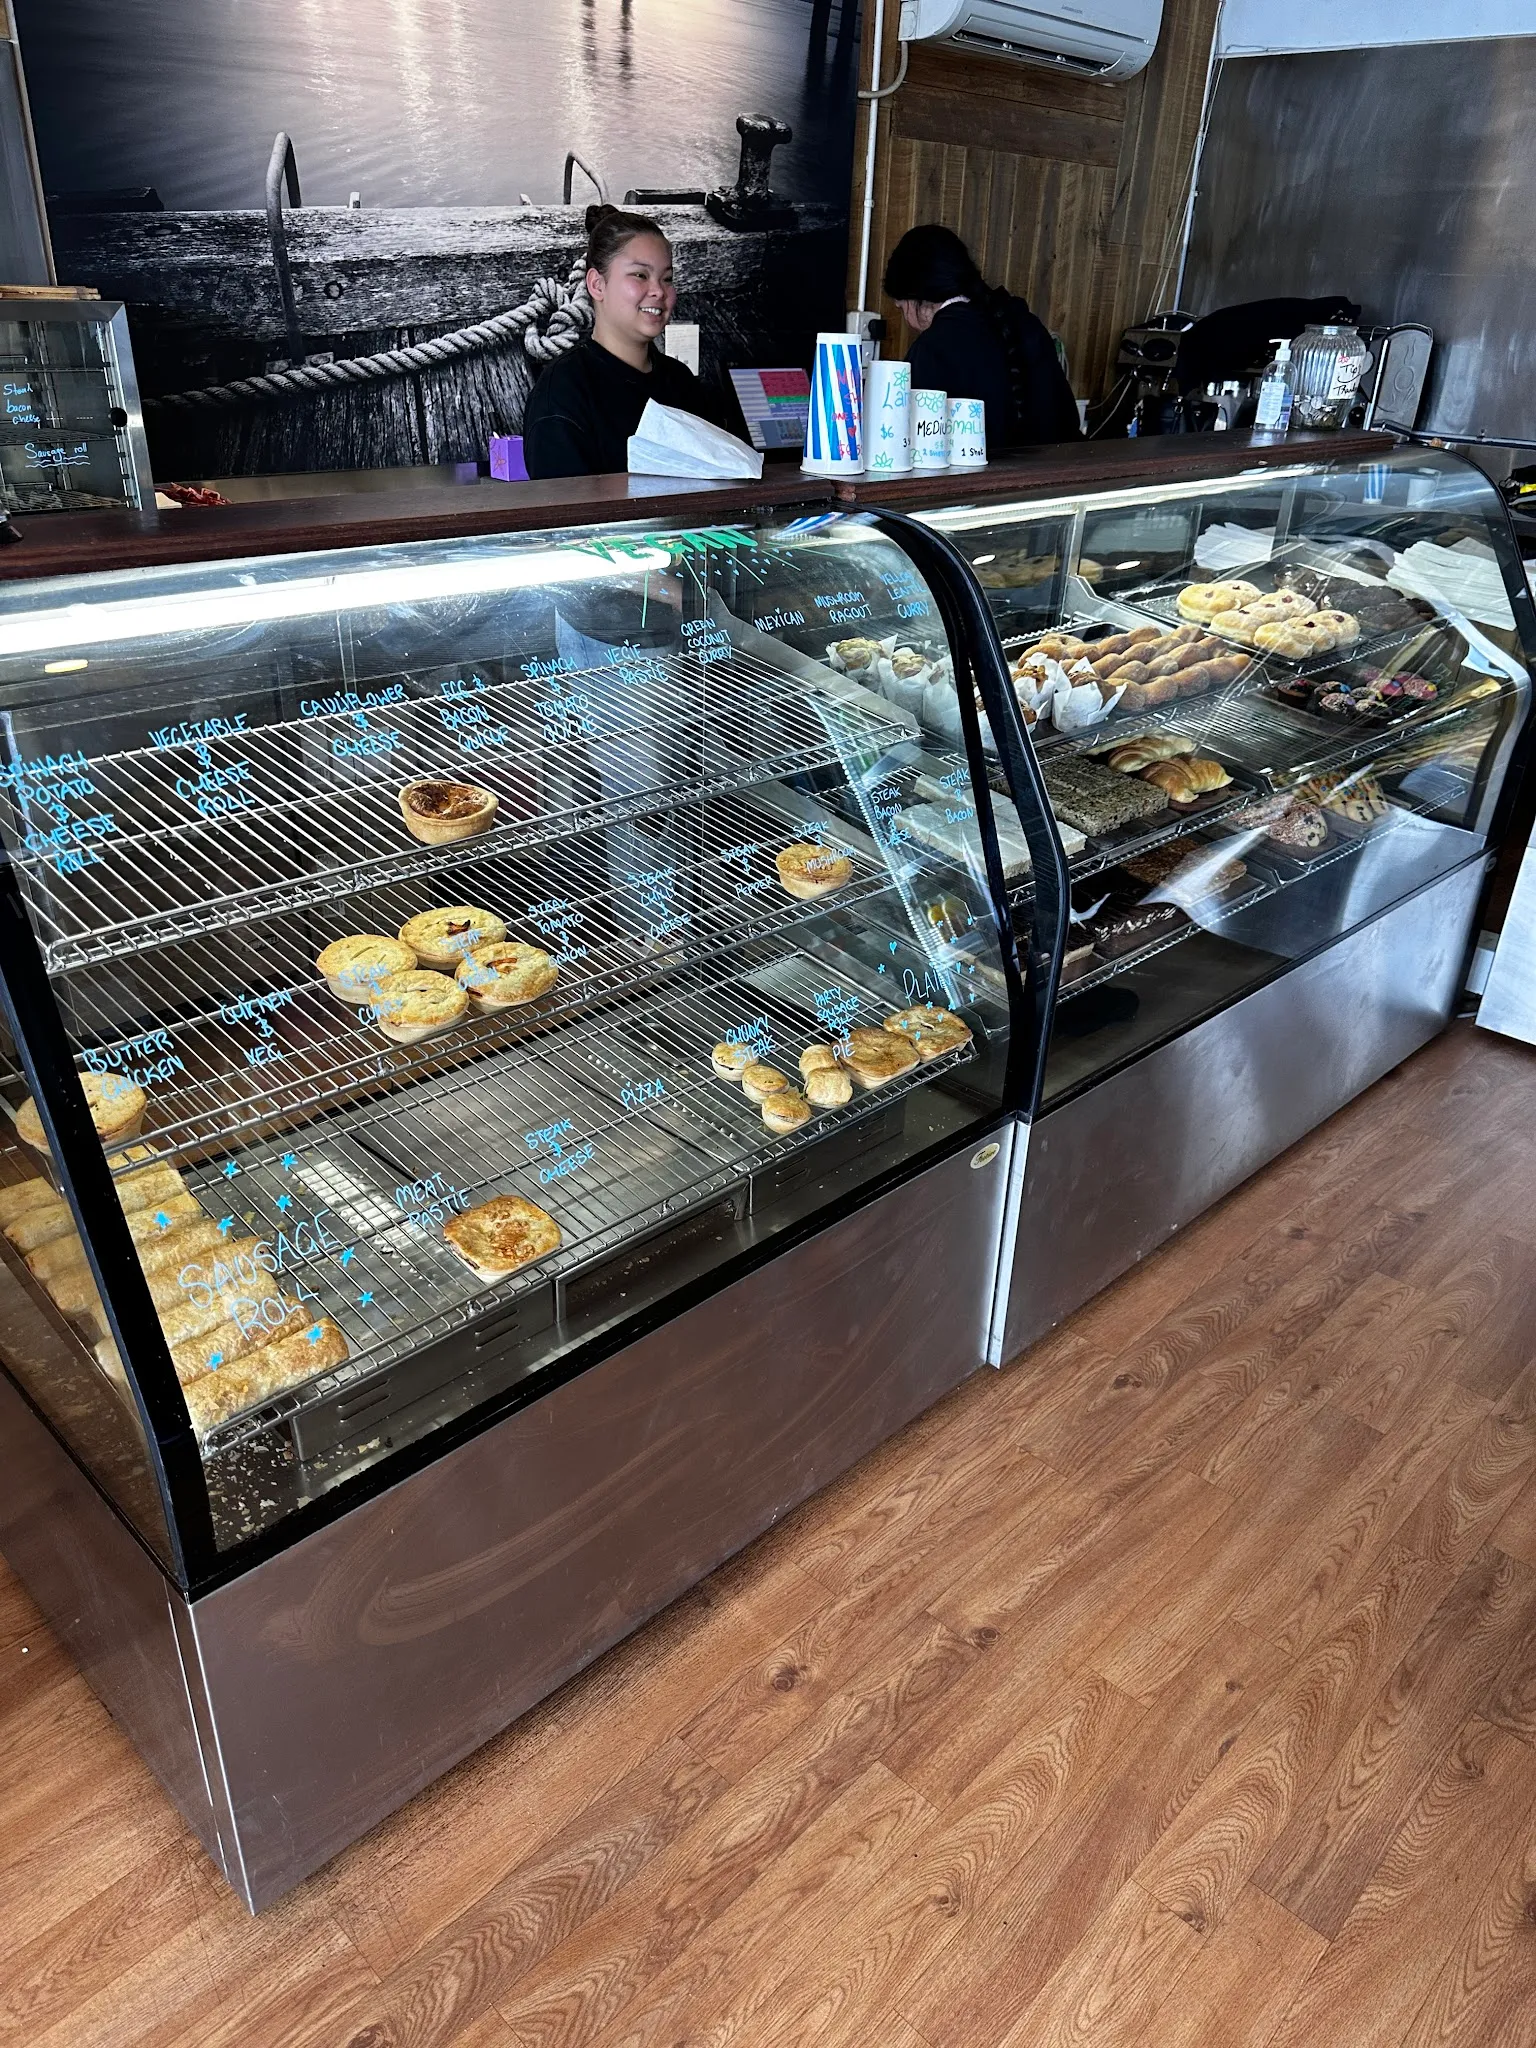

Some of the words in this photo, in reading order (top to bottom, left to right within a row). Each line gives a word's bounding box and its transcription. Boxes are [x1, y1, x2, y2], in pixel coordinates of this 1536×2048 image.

[6, 399, 32, 413] bacon
[880, 424, 895, 440] $6
[946, 419, 985, 435] SMALL
[25, 443, 66, 462] Sausage
[74, 442, 88, 454] roll
[556, 528, 758, 564] VEGAN
[814, 591, 866, 609] MUSHROOM
[897, 600, 930, 619] CURRY
[754, 608, 805, 633] MEXICAN
[829, 604, 873, 624] RAGOUT
[680, 618, 716, 637] GREEN
[688, 630, 732, 649] COCONUT
[604, 641, 648, 667] VEGIE
[698, 647, 733, 666] CURRY
[520, 656, 579, 679] SPINACH
[619, 660, 669, 685] PASTIE
[300, 683, 410, 717] CAULIFLOWER
[440, 680, 470, 701] EGG
[439, 705, 491, 731] BACON
[534, 695, 590, 720] TOMATO
[148, 713, 252, 750] VEGETABLE
[332, 731, 405, 757] CHEESE
[0, 751, 90, 788] SPINACH
[176, 761, 254, 799] CHEESE
[939, 768, 971, 789] STEAK
[15, 778, 95, 806] POTATO
[197, 790, 256, 818] ROLL
[870, 786, 902, 804] STEAK
[873, 803, 902, 820] BACON
[944, 806, 974, 824] BACON
[25, 813, 117, 851] CHEESE
[792, 820, 830, 838] STEAK
[54, 847, 105, 877] ROLL
[720, 842, 759, 863] STEAK
[805, 845, 857, 873] MUSHROOM
[735, 875, 776, 898] PEPPER
[527, 898, 571, 919] STEAK
[536, 913, 584, 935] TOMATO
[649, 912, 692, 940] CHEESE
[548, 945, 590, 968] ONION
[338, 962, 393, 988] STEAK
[220, 987, 294, 1025] CHICKEN
[814, 986, 841, 1007] PARTY
[725, 1015, 771, 1046] CHUNKY
[828, 1014, 853, 1032] ROLL
[82, 1031, 175, 1075] BUTTER
[242, 1042, 285, 1066] VEG
[732, 1034, 776, 1066] STEAK
[832, 1038, 856, 1061] PIE
[101, 1055, 186, 1101] CHICKEN
[620, 1078, 666, 1111] PIZZA
[523, 1118, 576, 1150] STEAK
[539, 1143, 597, 1185] CHEESE
[394, 1172, 451, 1211] MEAT
[406, 1187, 472, 1231] PASTIE
[178, 1209, 340, 1309] SAUSAGE
[229, 1283, 320, 1341] ROLL
